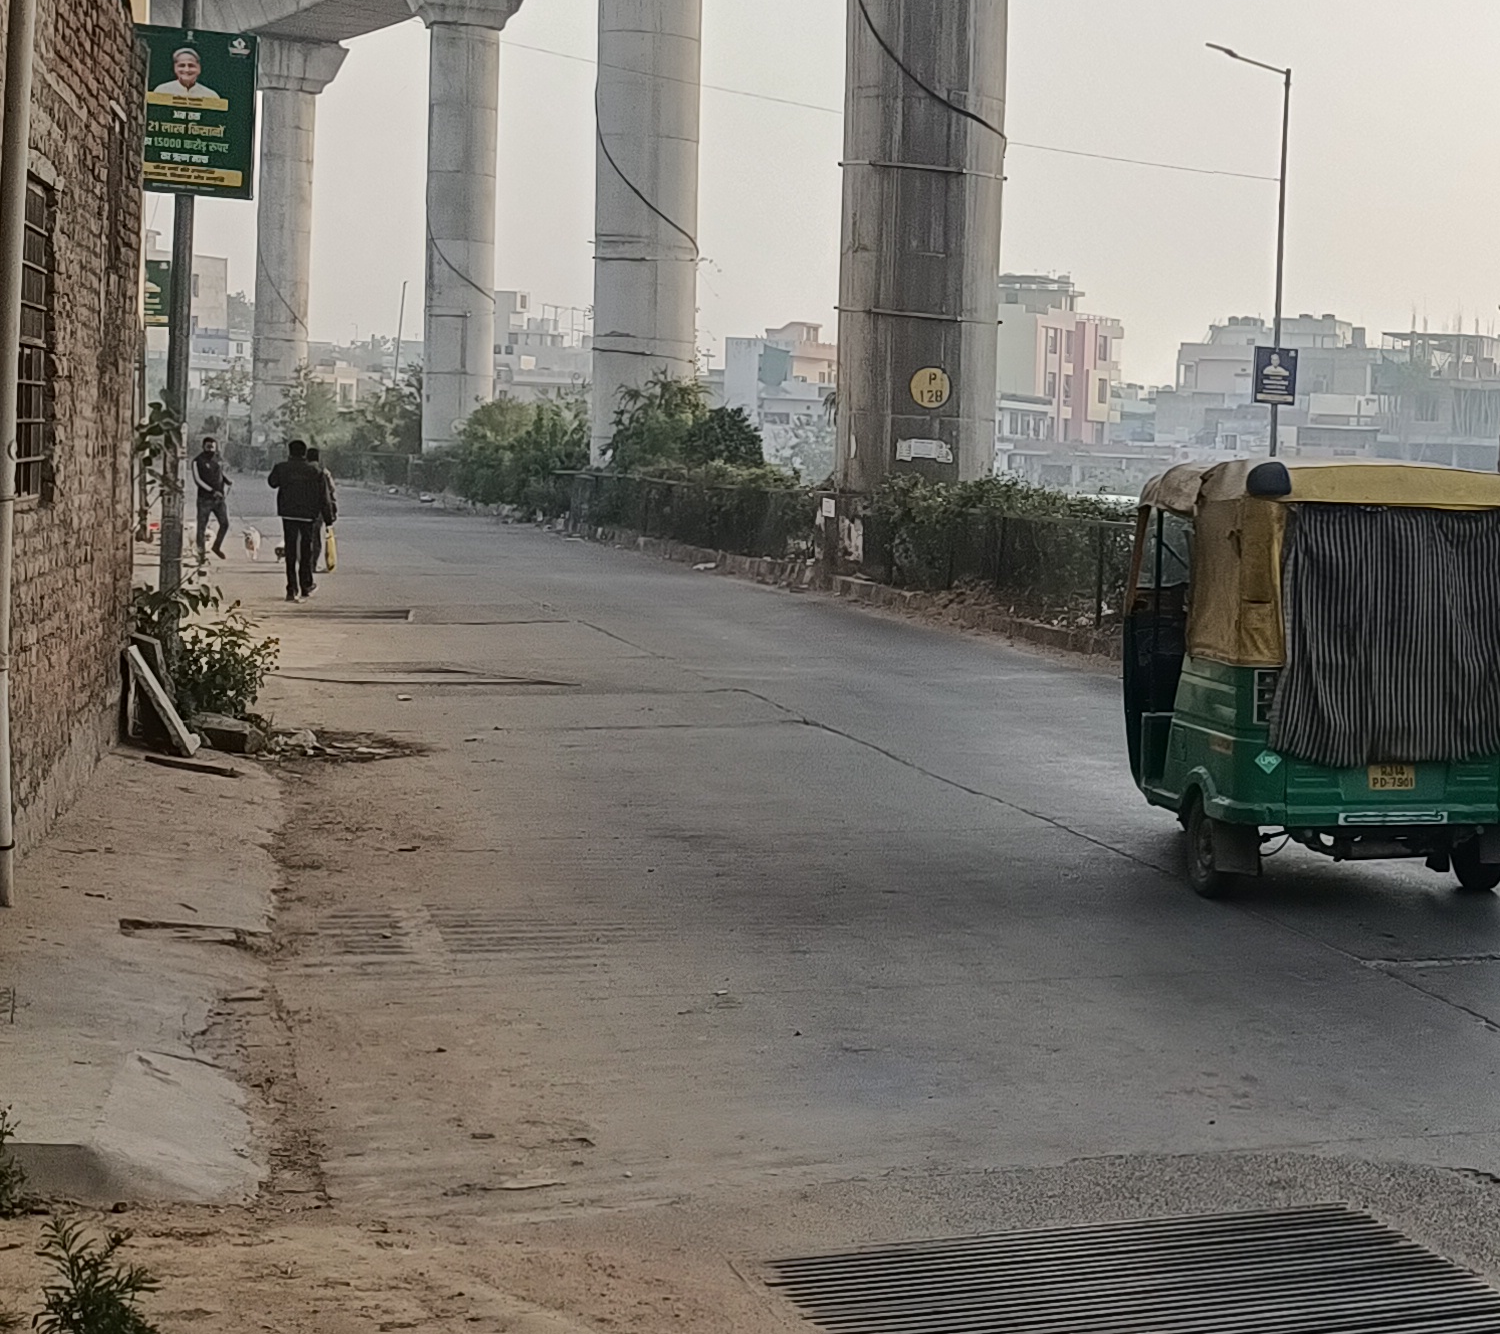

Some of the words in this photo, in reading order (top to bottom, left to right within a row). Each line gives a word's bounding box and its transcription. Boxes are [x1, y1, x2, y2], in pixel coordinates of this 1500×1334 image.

[148, 121, 160, 132] 21
[154, 137, 182, 148] 15000
[928, 372, 938, 386] P
[919, 390, 943, 403] 128
[1260, 755, 1277, 764] LPG
